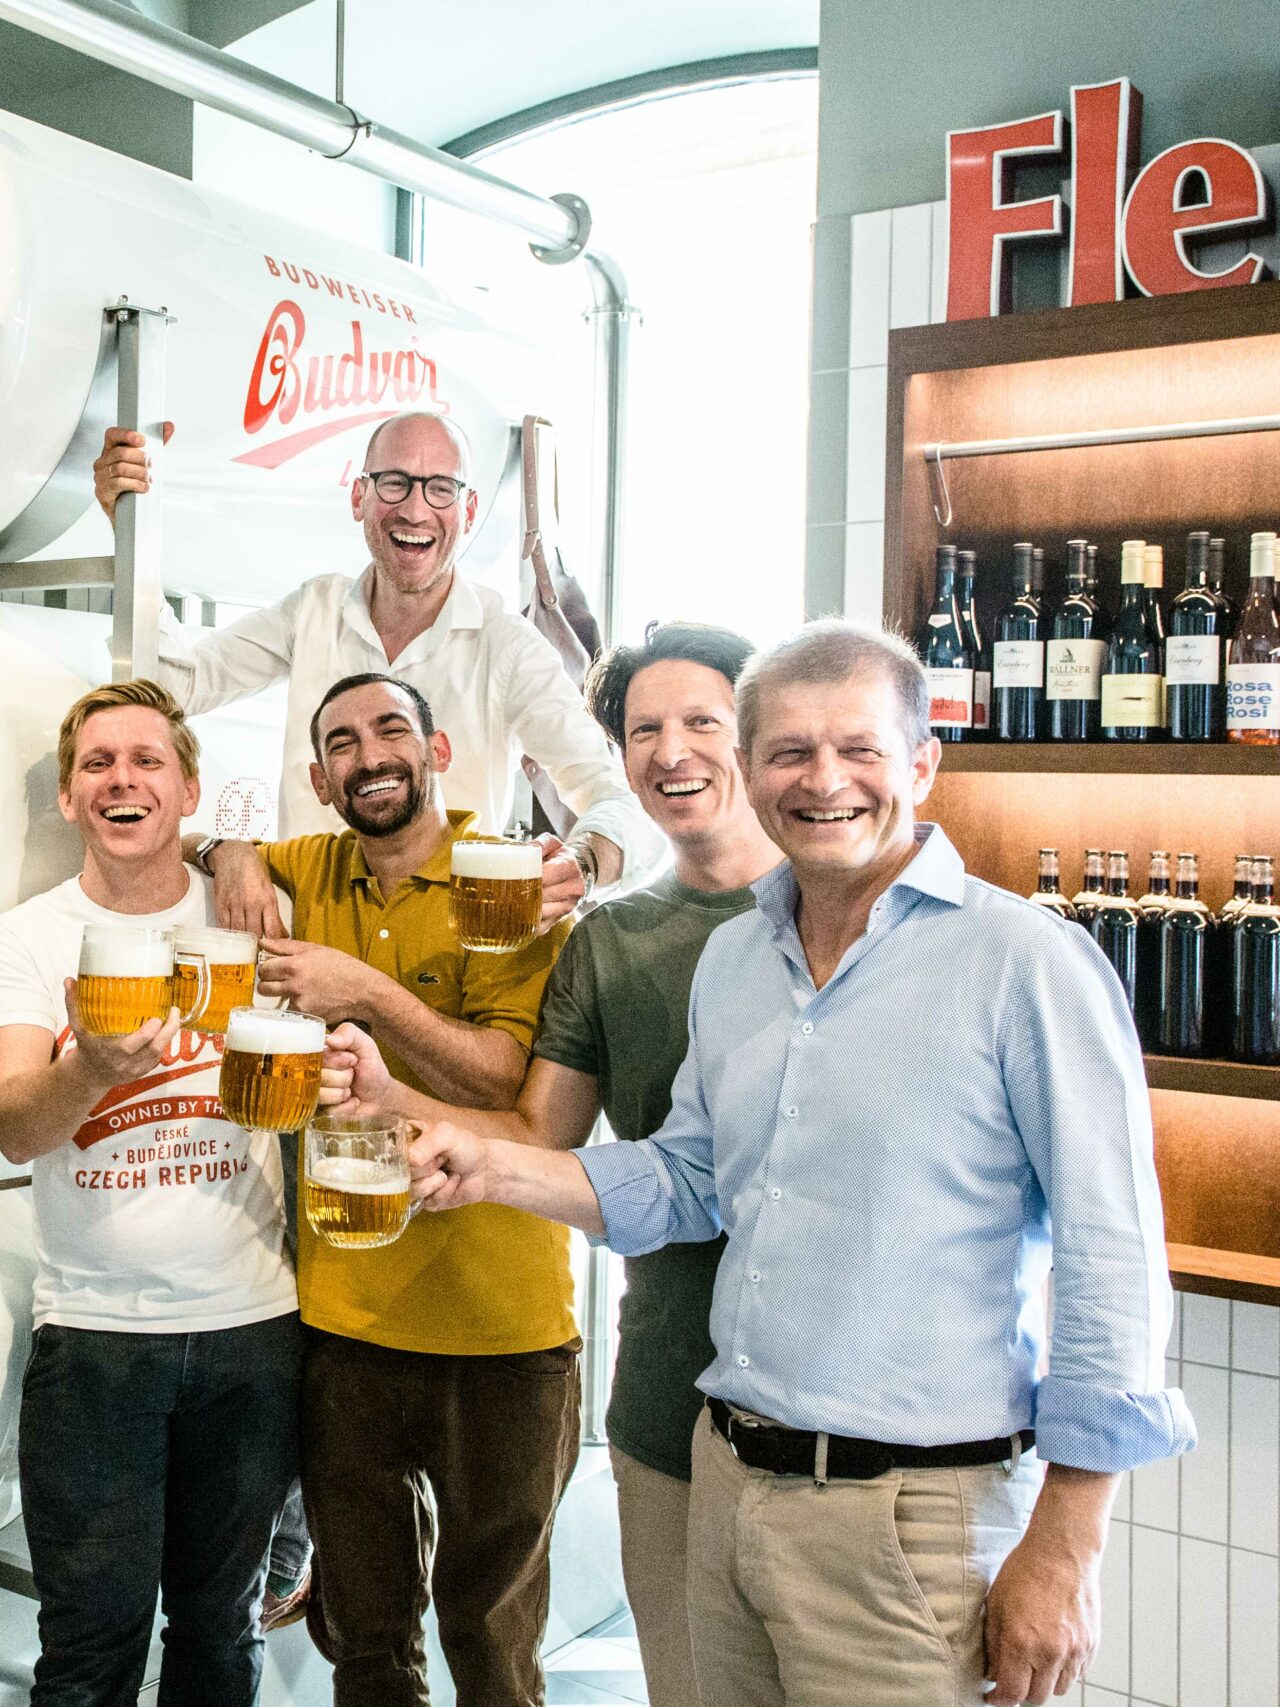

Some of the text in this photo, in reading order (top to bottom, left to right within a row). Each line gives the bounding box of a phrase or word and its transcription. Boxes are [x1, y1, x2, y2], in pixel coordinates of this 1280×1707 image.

[264, 255, 417, 324] BUDWEISER
[244, 300, 450, 434] Budvar
[1049, 665, 1091, 674] WALLNER
[109, 1100, 223, 1128] OWNED BY TH
[154, 1125, 189, 1142] ČESKÉ
[75, 1168, 146, 1189] CZECH
